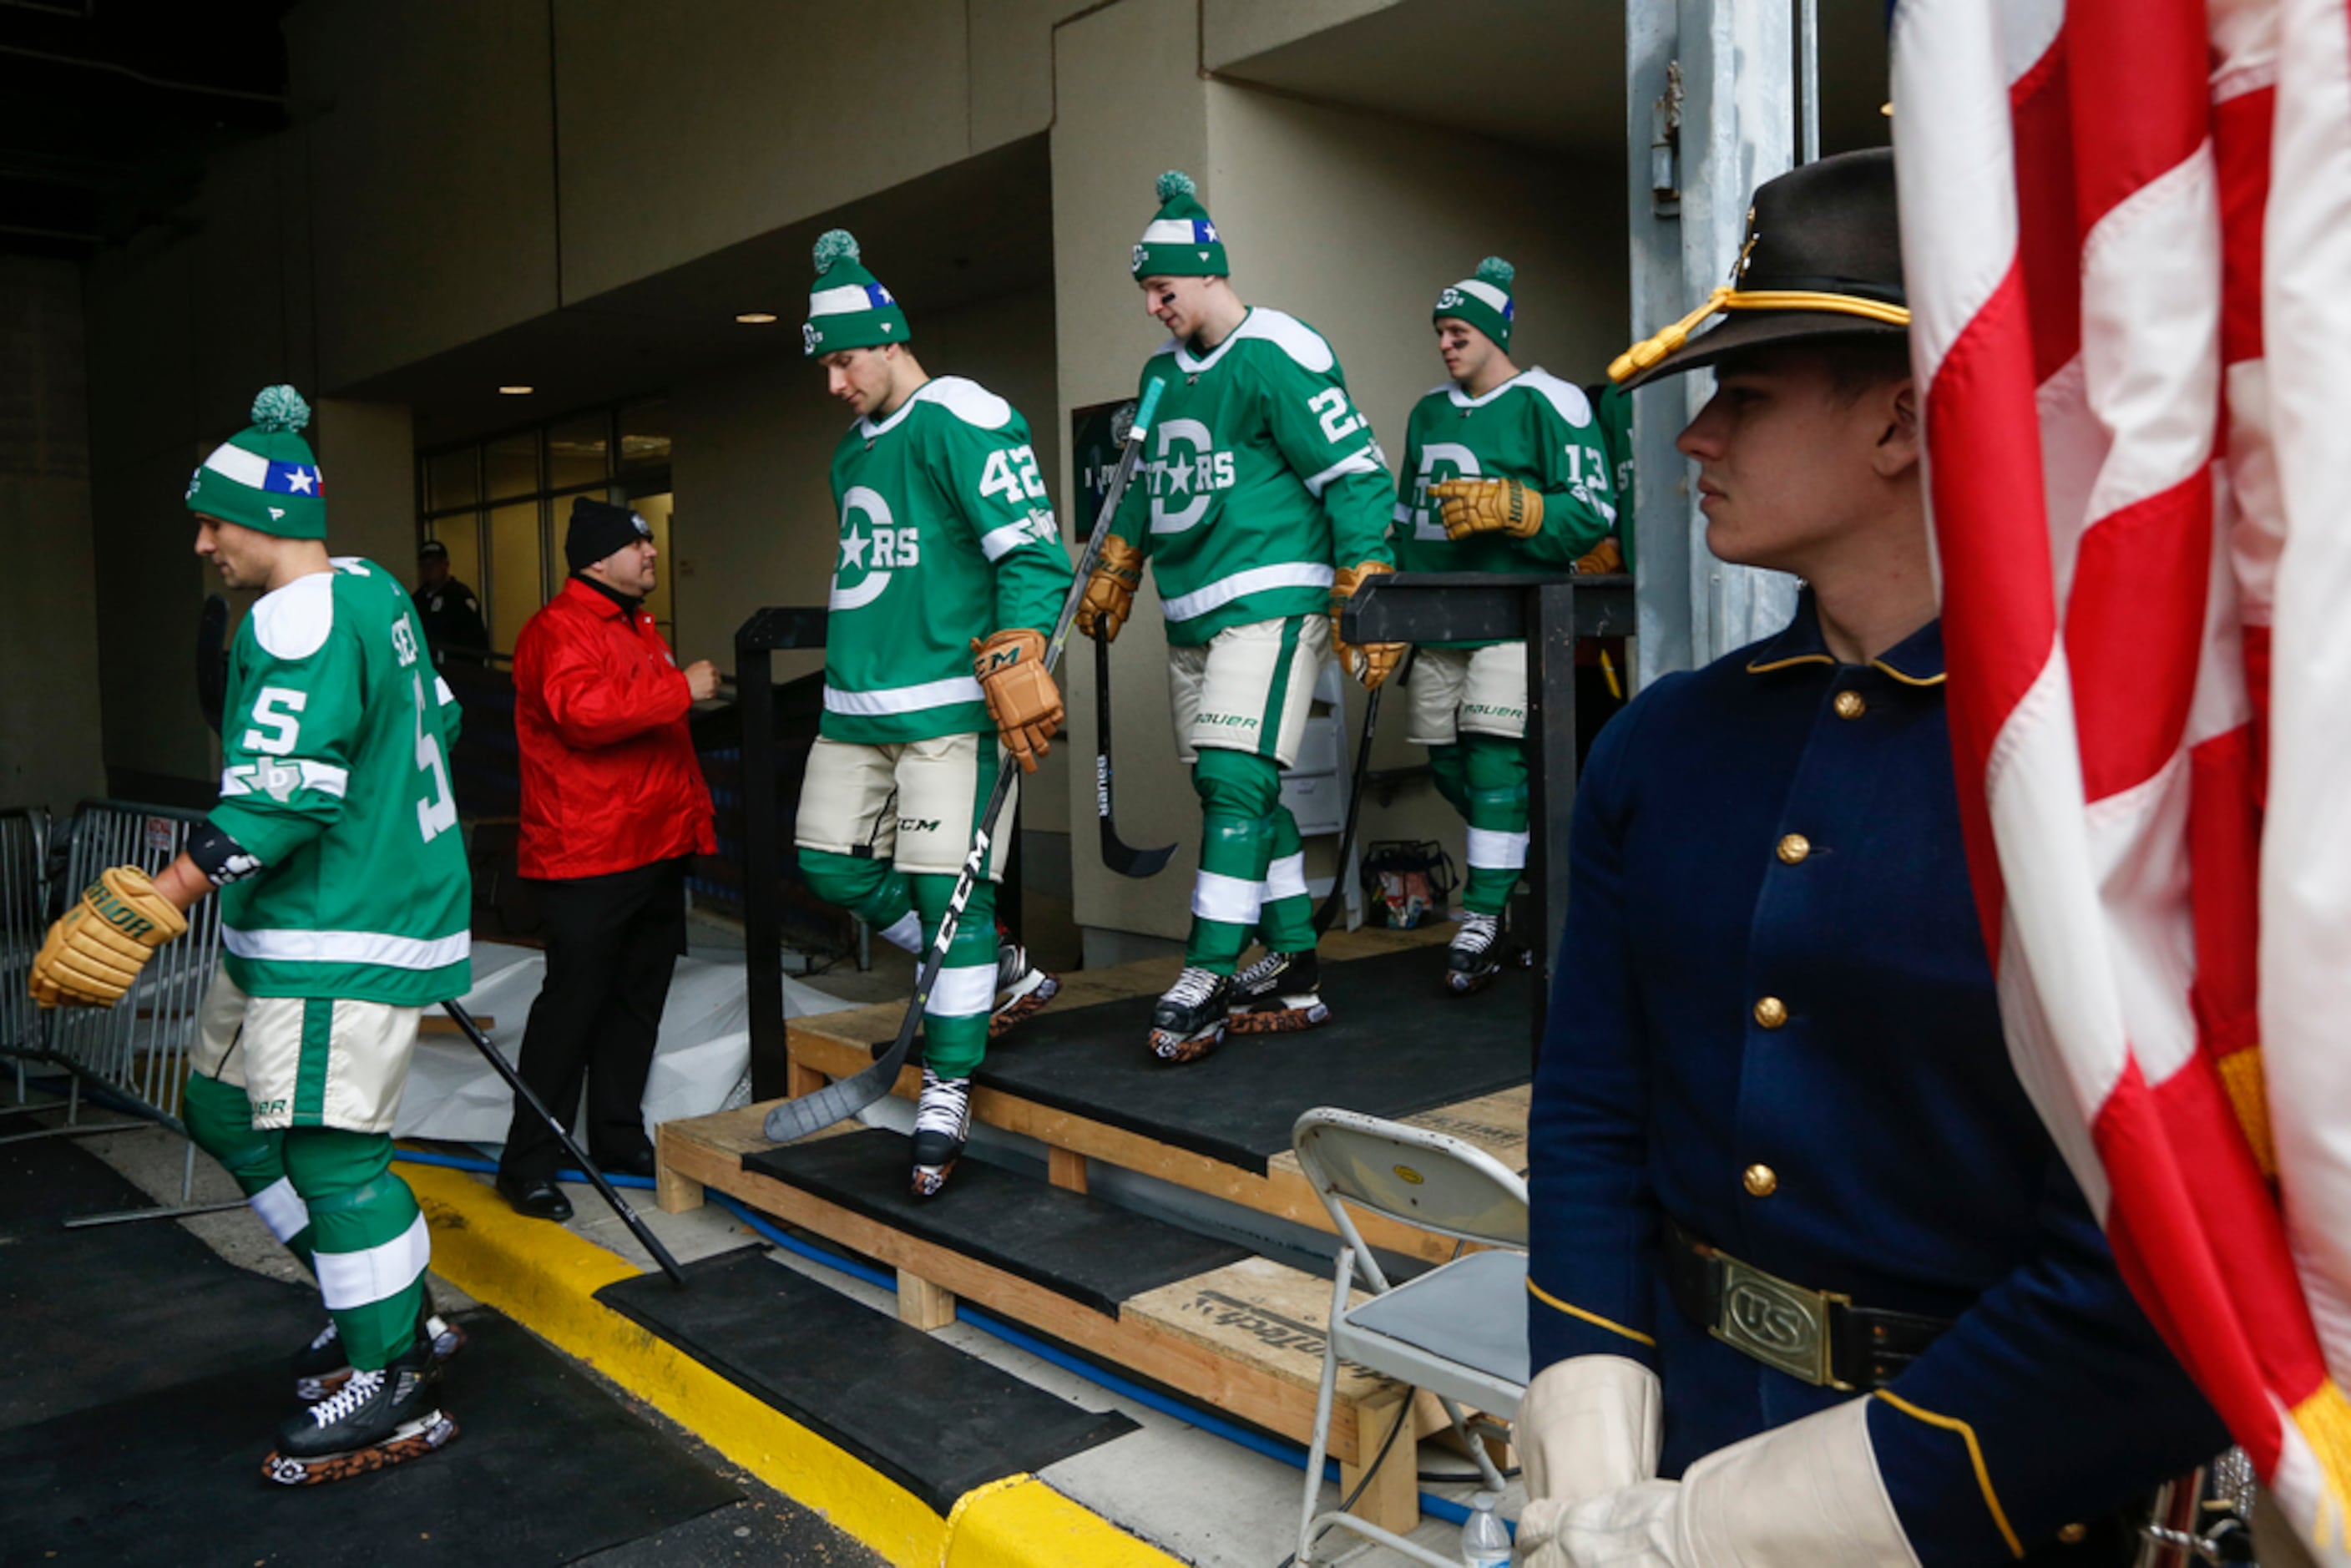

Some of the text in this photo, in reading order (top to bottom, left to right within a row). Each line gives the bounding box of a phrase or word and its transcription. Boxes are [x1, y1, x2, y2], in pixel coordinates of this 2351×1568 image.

[1307, 387, 1368, 443] 2
[978, 443, 1047, 504] 42
[1565, 444, 1608, 491] 13
[974, 645, 1020, 678] CM
[243, 685, 308, 756] 5
[897, 817, 942, 832] CM
[933, 828, 990, 953] CCM
[1739, 1286, 1802, 1343] US
